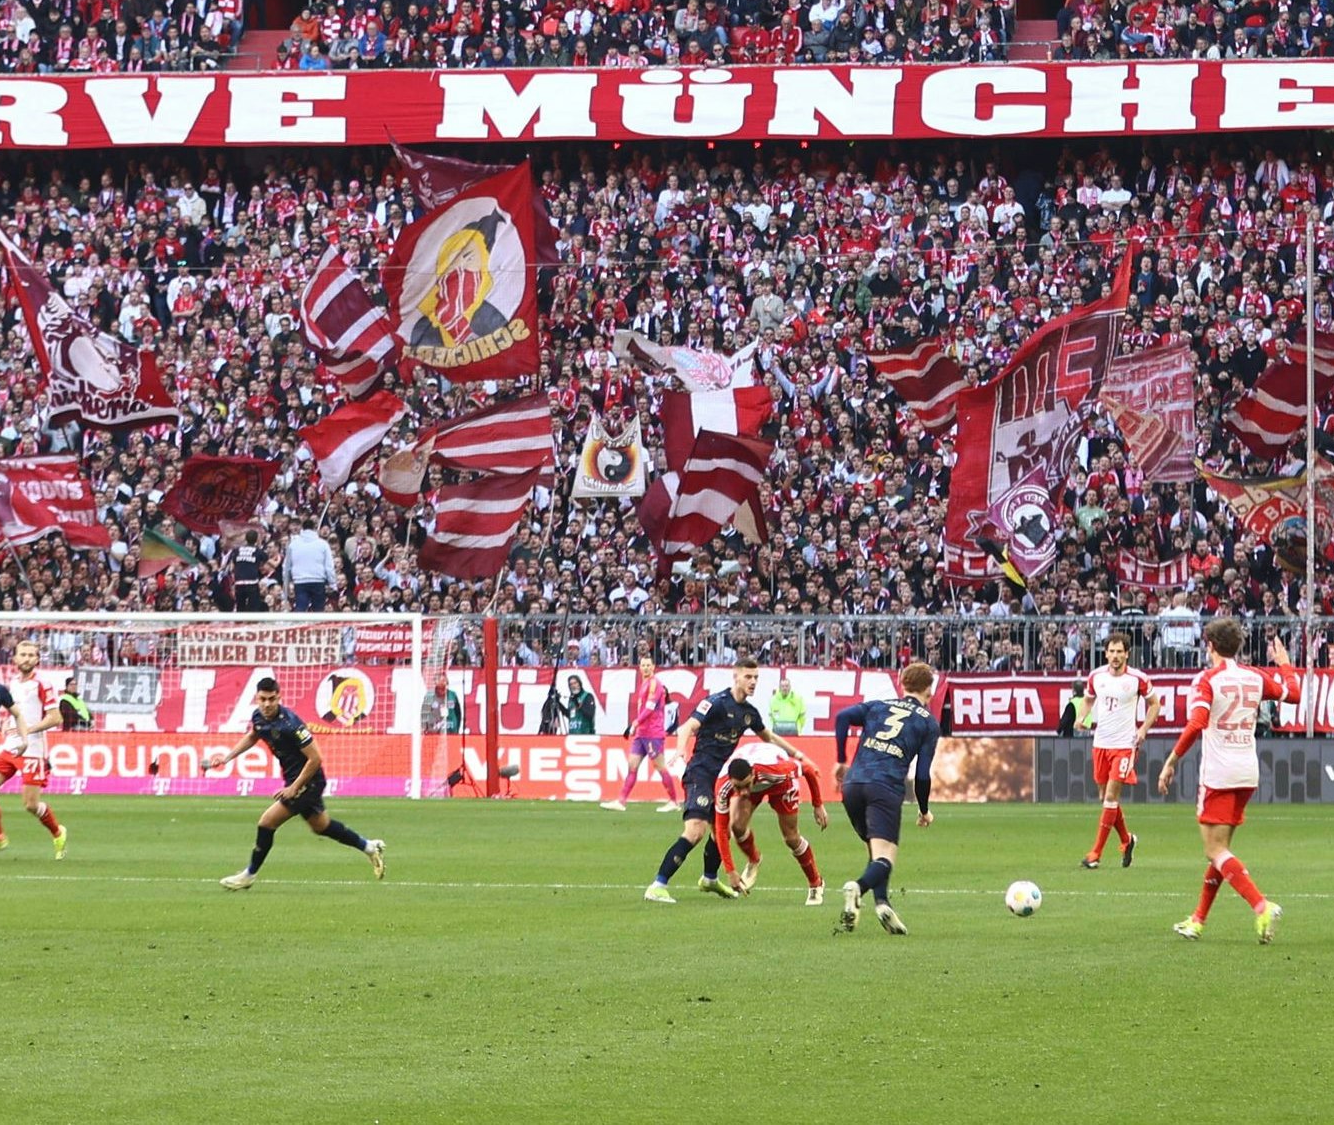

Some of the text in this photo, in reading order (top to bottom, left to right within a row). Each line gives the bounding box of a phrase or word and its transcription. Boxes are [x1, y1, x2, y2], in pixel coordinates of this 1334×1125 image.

[297, 645, 337, 662] UNS
[1217, 686, 1259, 731] 25
[875, 706, 912, 741] 3
[1223, 729, 1252, 744] MÜLLER
[22, 759, 37, 773] 27
[1119, 757, 1130, 772] 8
